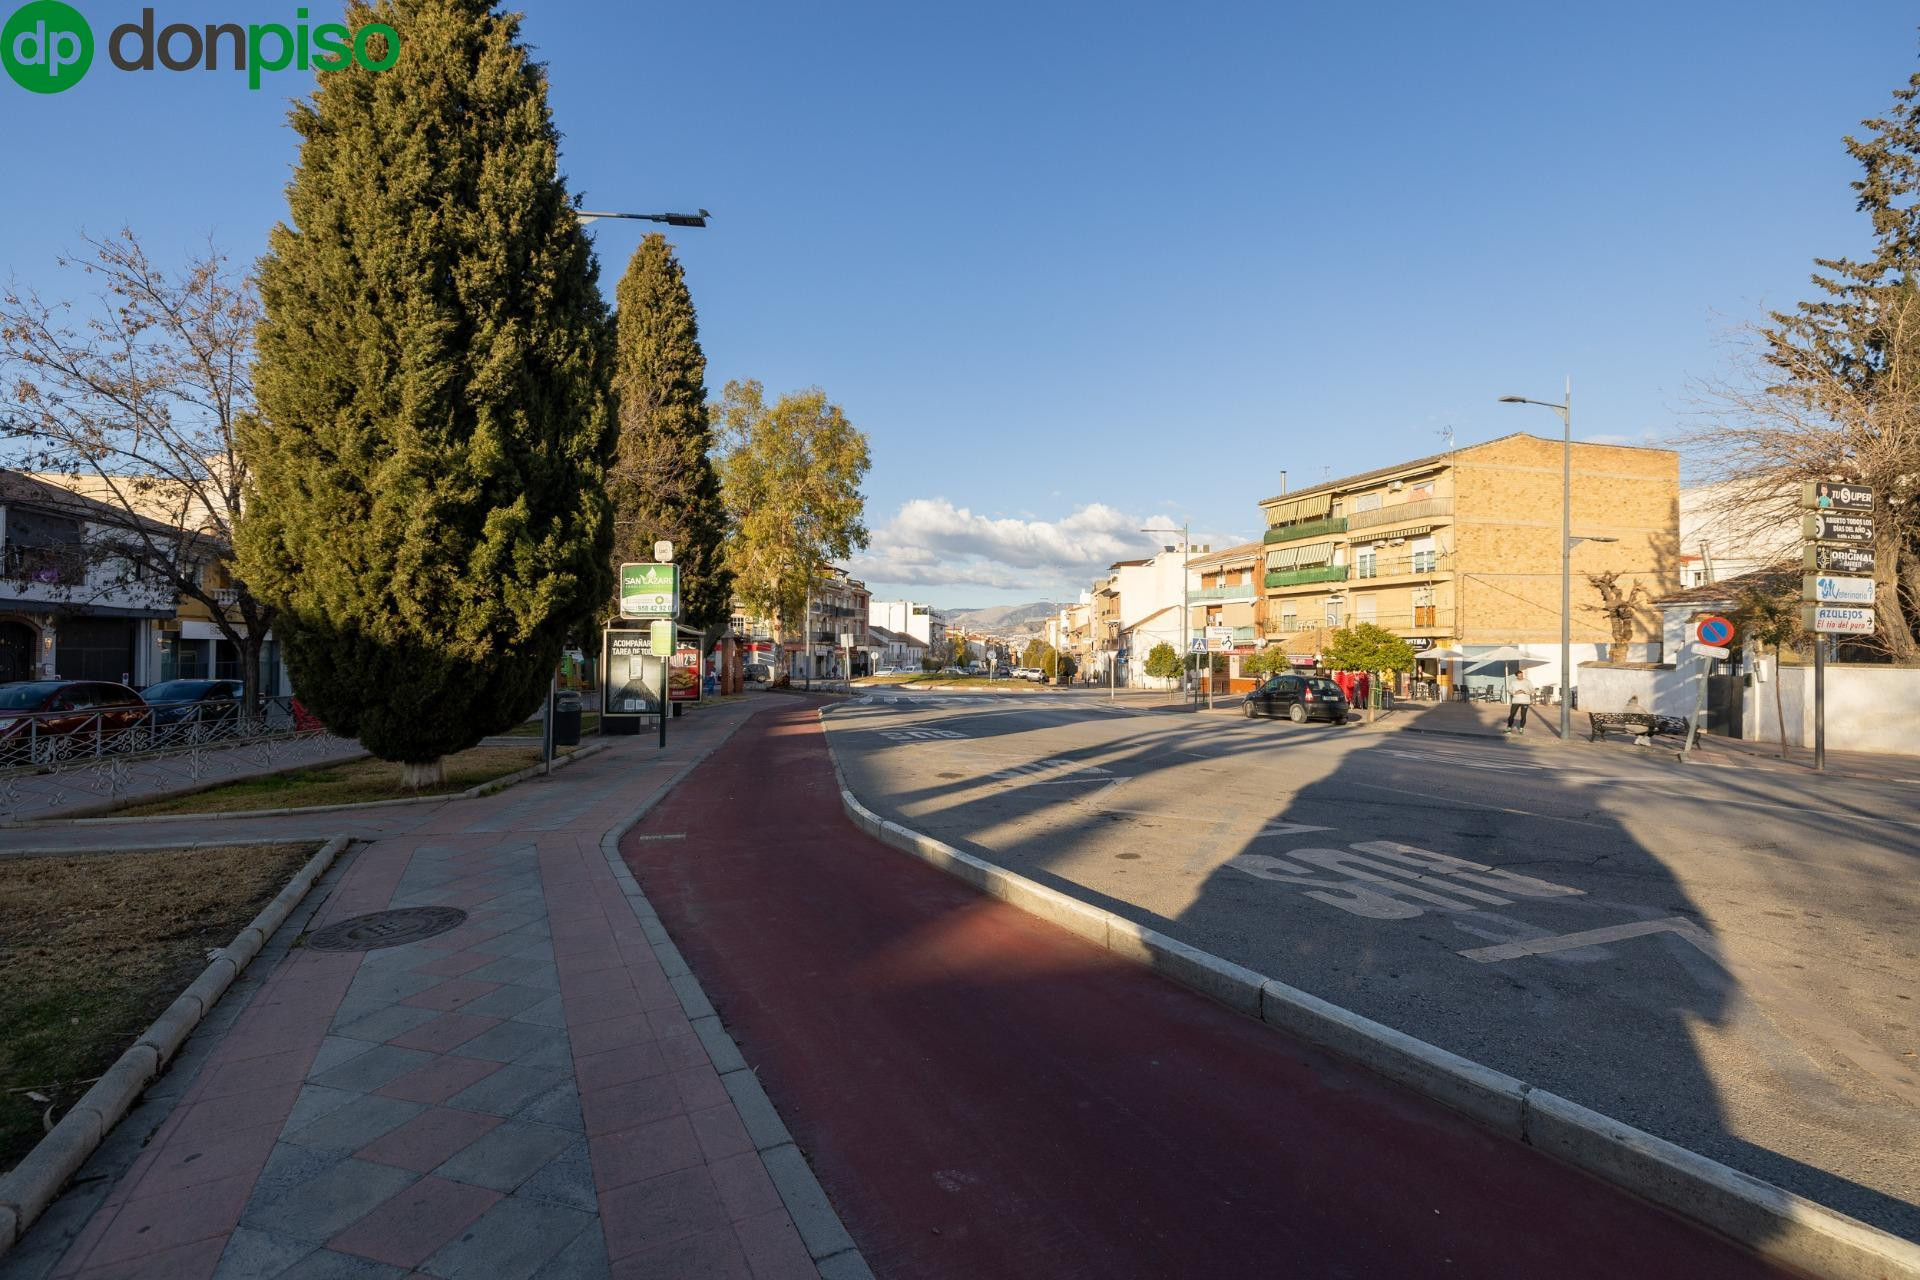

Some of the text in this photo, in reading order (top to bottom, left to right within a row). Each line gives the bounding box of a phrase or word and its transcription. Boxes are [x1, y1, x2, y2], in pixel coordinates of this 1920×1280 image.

[1863, 519, 1872, 527] LOS
[1855, 524, 1866, 534] AÑO
[1832, 551, 1874, 563] ORIGINAL
[625, 577, 641, 585] SAN
[1819, 610, 1863, 620] AZULEJOS
[1817, 619, 1824, 628] El
[1838, 620, 1848, 629] del
[612, 648, 631, 656] TAREA
[1224, 841, 1588, 919] BUS
